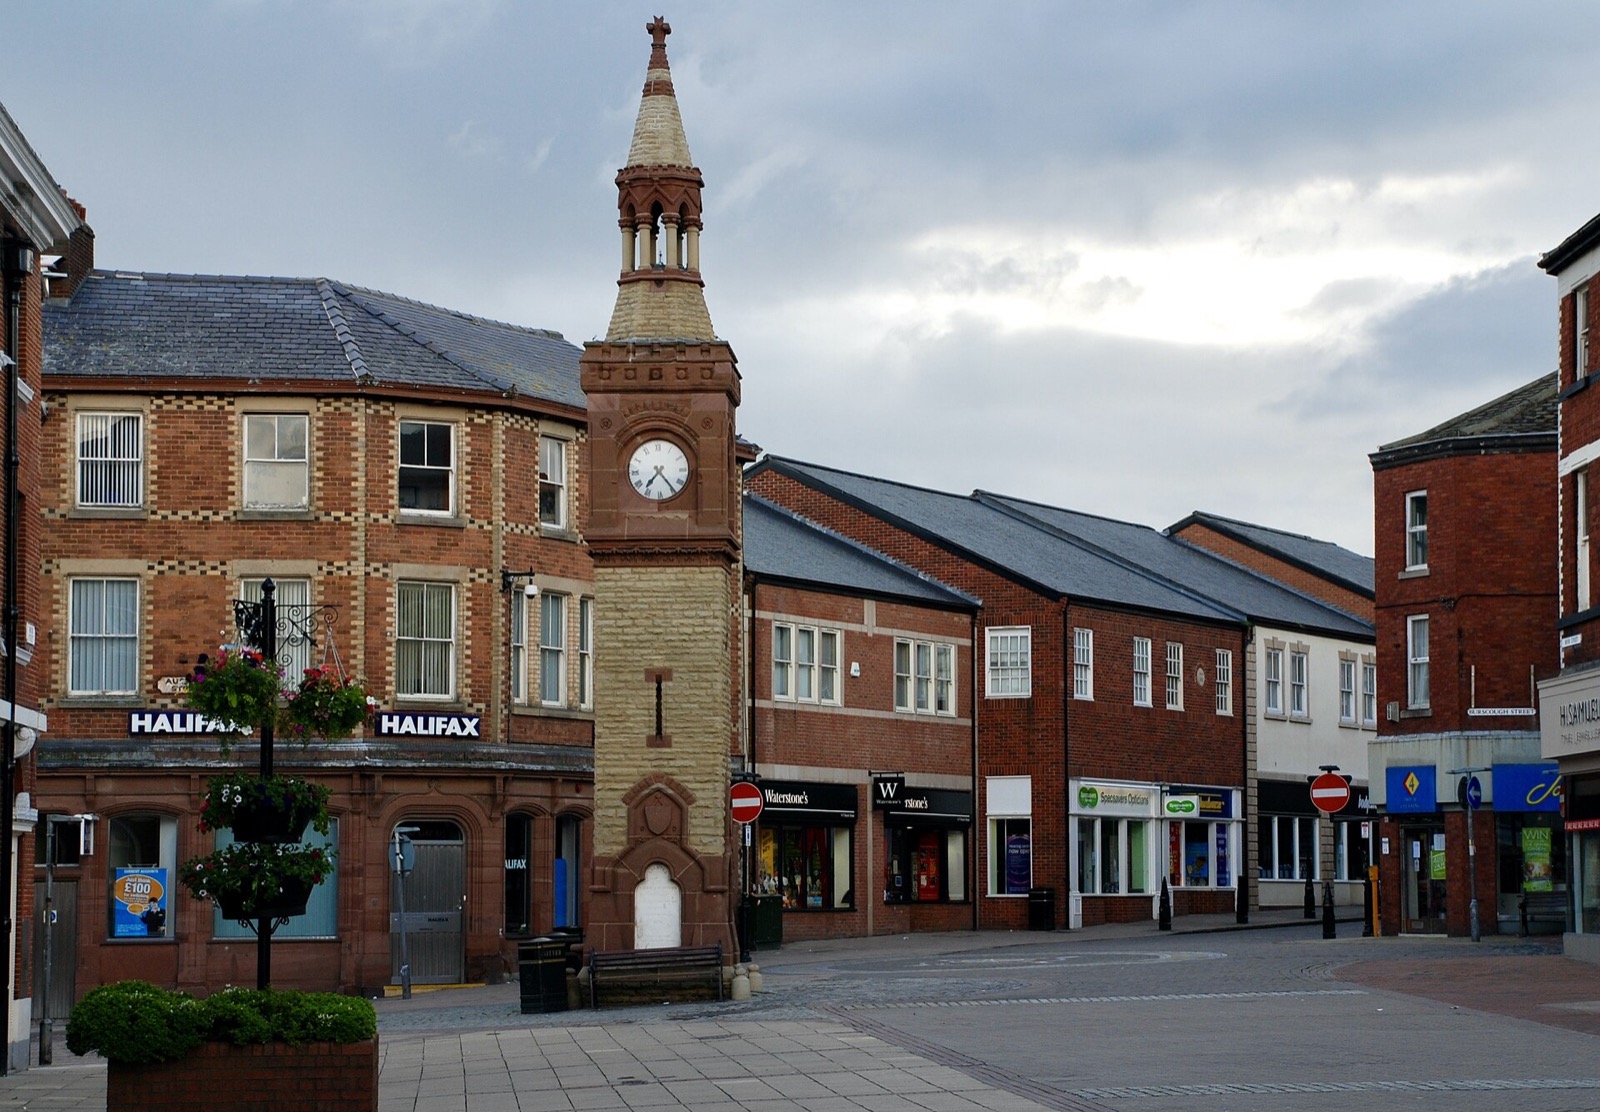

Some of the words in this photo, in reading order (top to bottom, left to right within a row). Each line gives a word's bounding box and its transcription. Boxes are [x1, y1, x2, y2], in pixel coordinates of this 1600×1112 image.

[381, 714, 480, 736] HALIFAX
[878, 782, 898, 799] W
[1408, 776, 1415, 792] 4
[764, 789, 809, 805] Waterstone's
[1100, 791, 1127, 805] Specsavers
[1127, 793, 1149, 806] Opticians
[1523, 830, 1549, 840] WIN
[125, 882, 151, 894] £100
